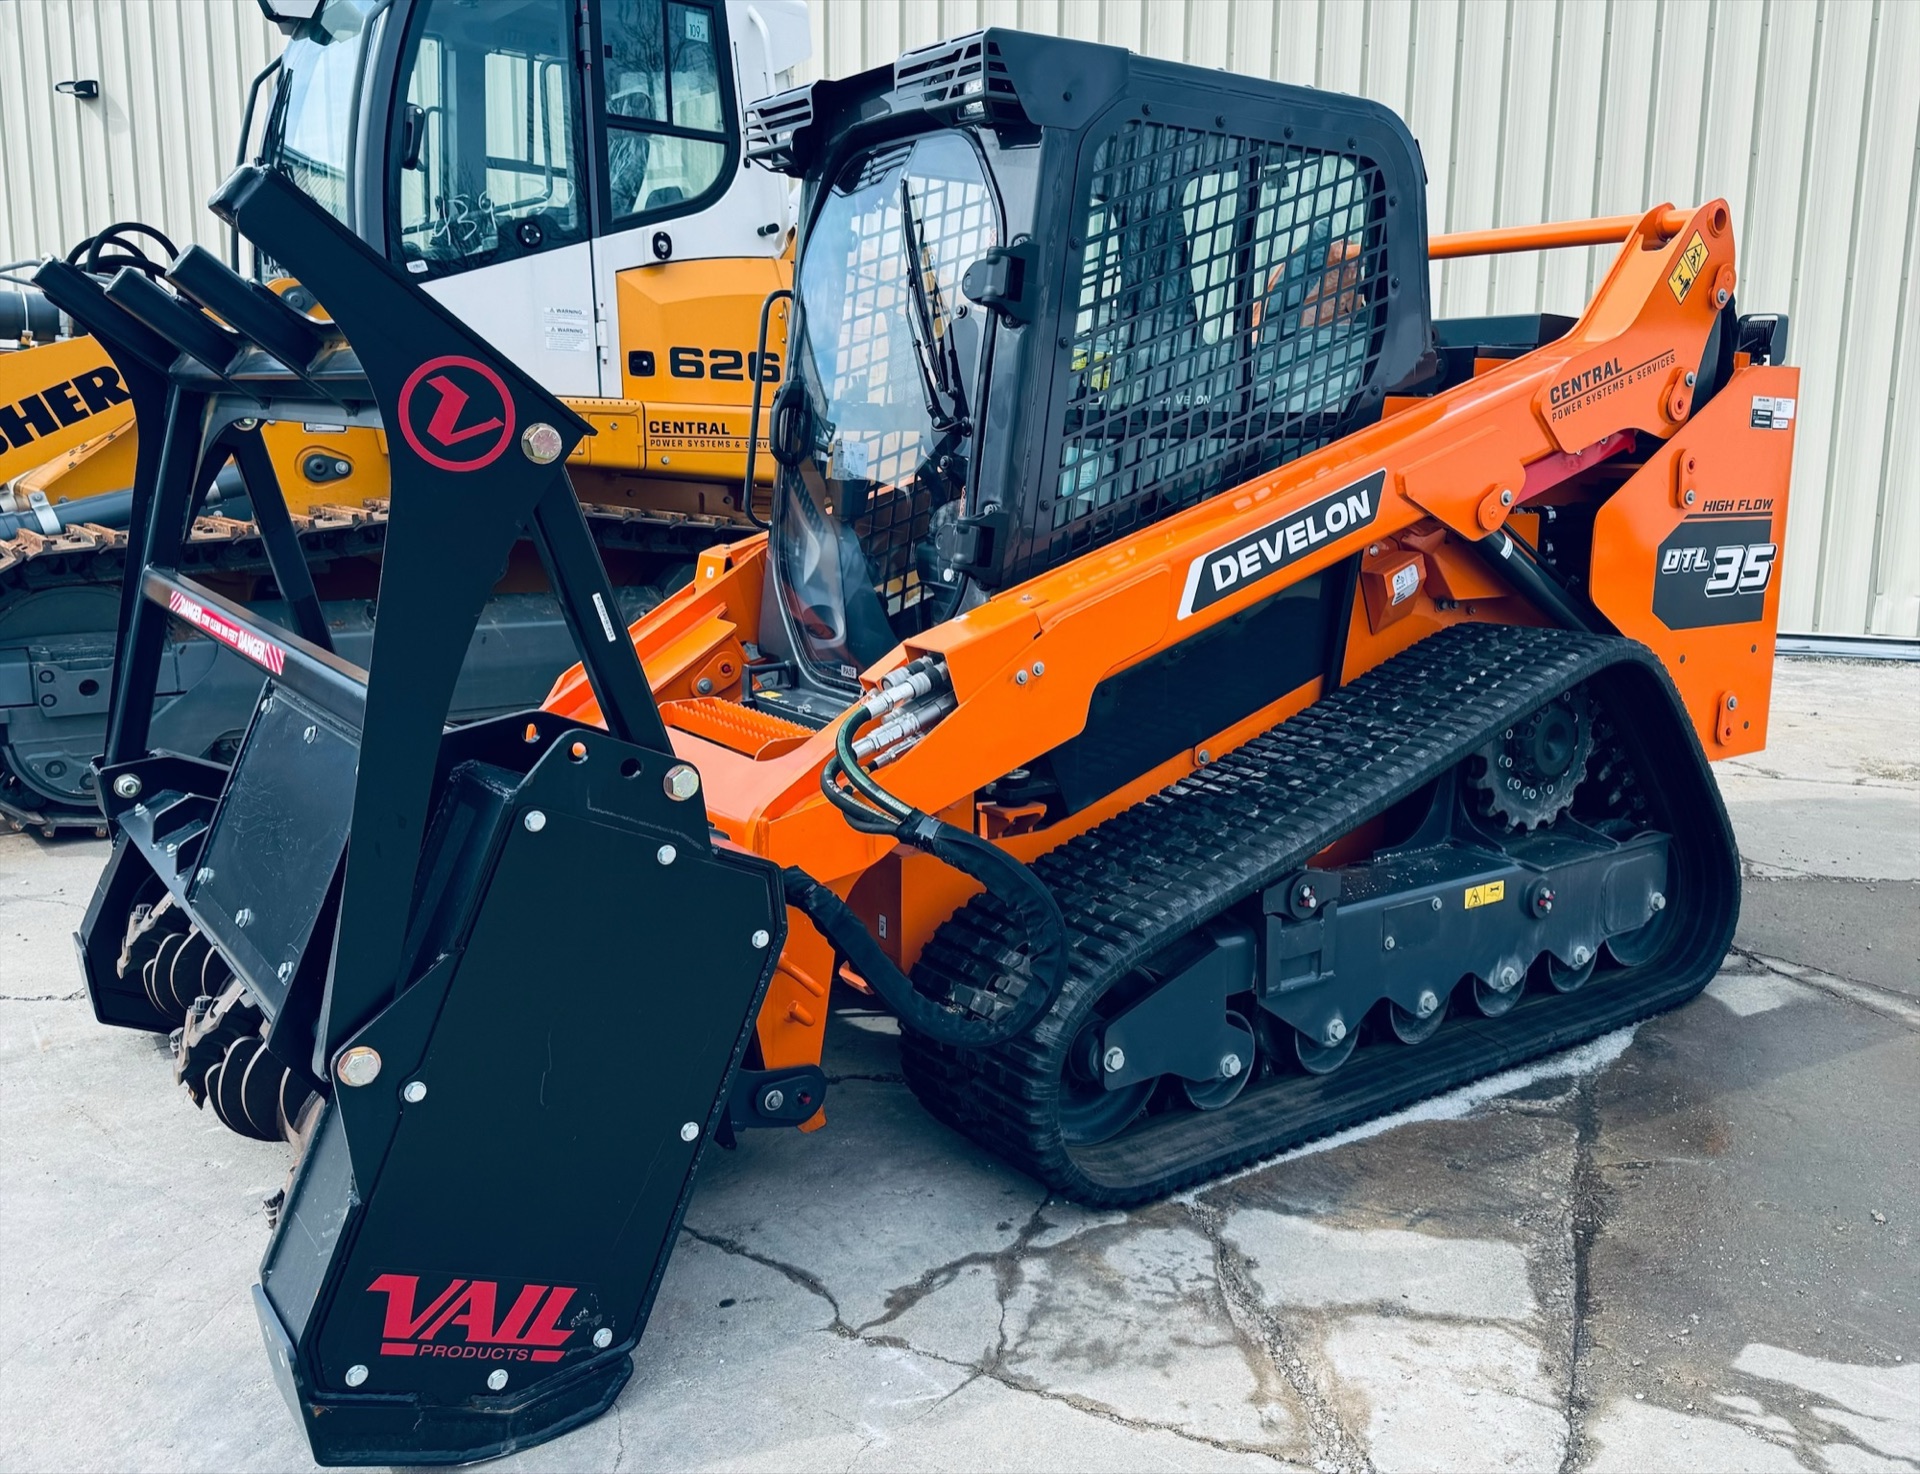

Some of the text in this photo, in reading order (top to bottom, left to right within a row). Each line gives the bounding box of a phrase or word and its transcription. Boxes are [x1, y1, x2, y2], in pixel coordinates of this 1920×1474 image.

[670, 346, 781, 383] 626
[1550, 357, 1623, 405] CENTRAL
[1552, 354, 1676, 422] POWER SYSTEMS & SERVICES
[649, 420, 730, 435] CENTRAL
[650, 438, 768, 449] POWER SYSTEMS & SRV
[1702, 499, 1774, 512] HIGH FLOW
[1211, 489, 1371, 592] DEVELON
[1662, 543, 1778, 598] DTL 35
[180, 598, 202, 625] DANGER
[238, 631, 266, 665] DANGER
[843, 667, 855, 677] PASS
[366, 1273, 578, 1346] VAIL
[419, 1344, 529, 1361] PRODUCTS
